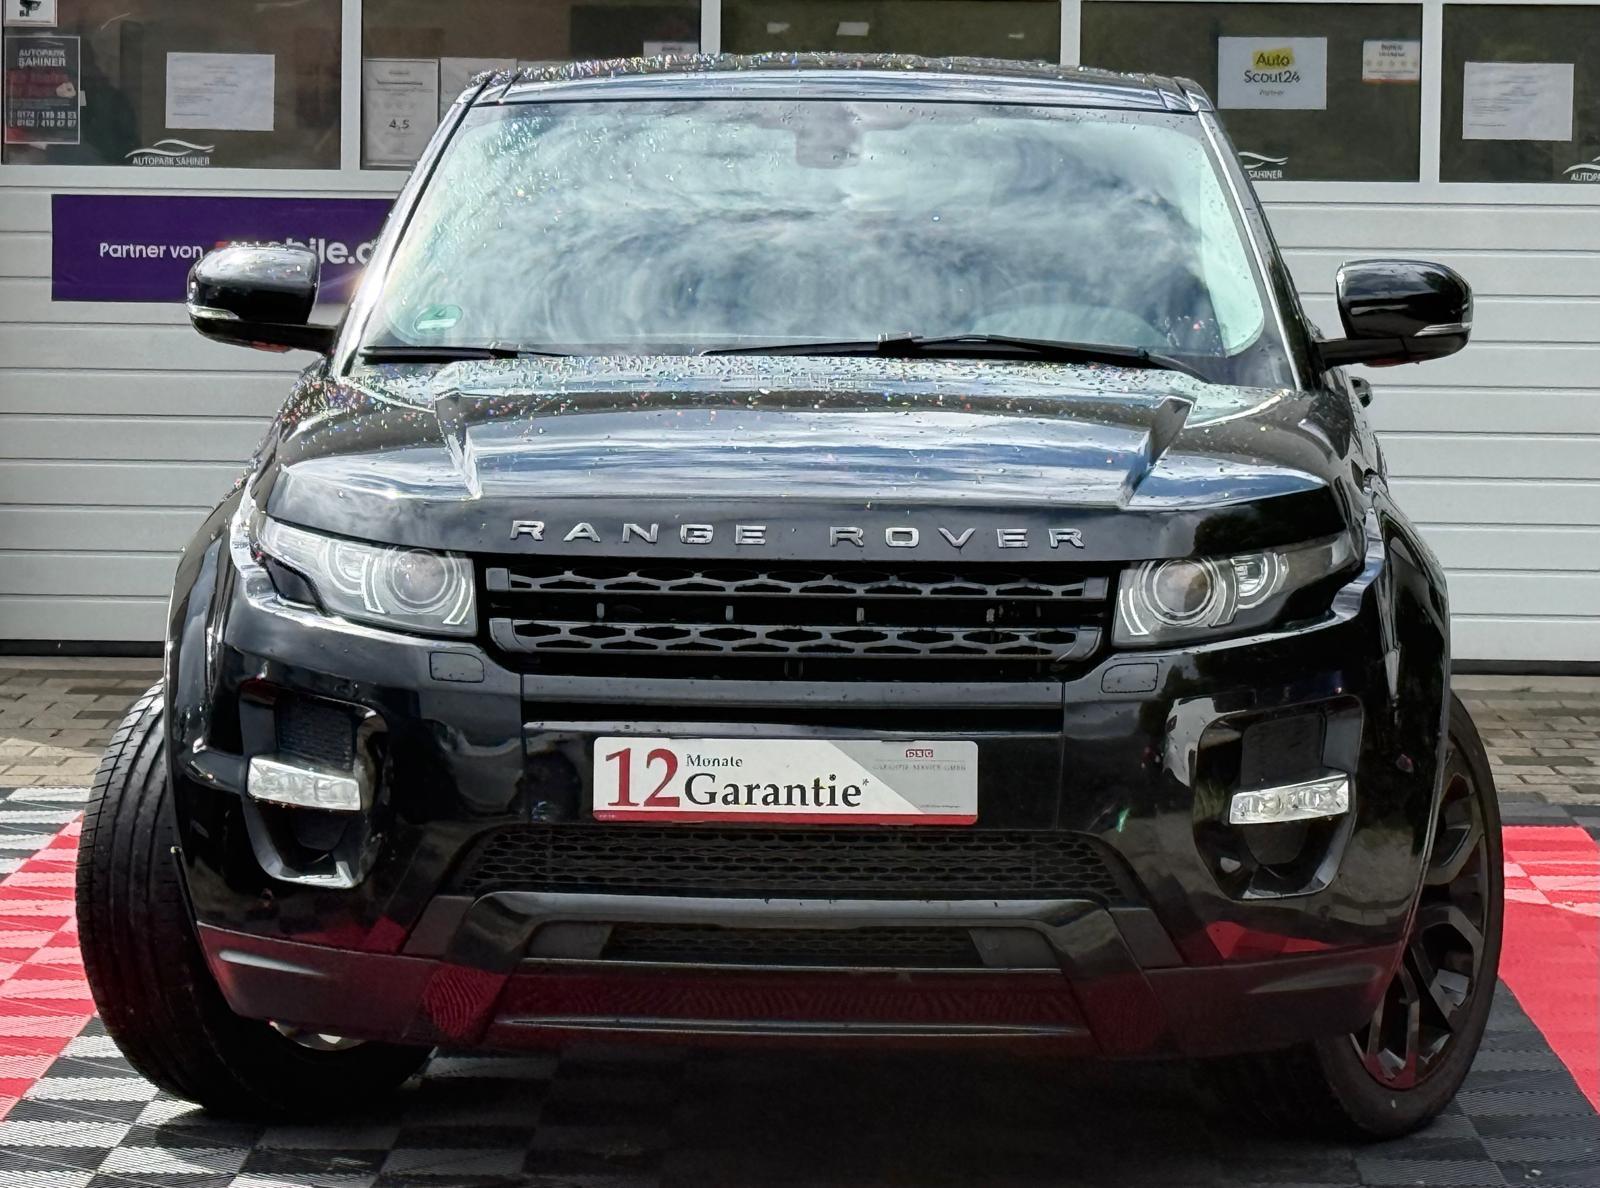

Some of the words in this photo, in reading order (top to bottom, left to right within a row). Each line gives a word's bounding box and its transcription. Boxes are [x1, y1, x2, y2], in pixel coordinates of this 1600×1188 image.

[1256, 53, 1290, 66] Auto
[1244, 70, 1300, 83] Scout24
[100, 242, 166, 259] Partner
[170, 246, 203, 259] von
[509, 520, 767, 545] RANGE
[829, 526, 1085, 549] ROVER
[605, 748, 681, 808] 12
[686, 754, 743, 767] Monate
